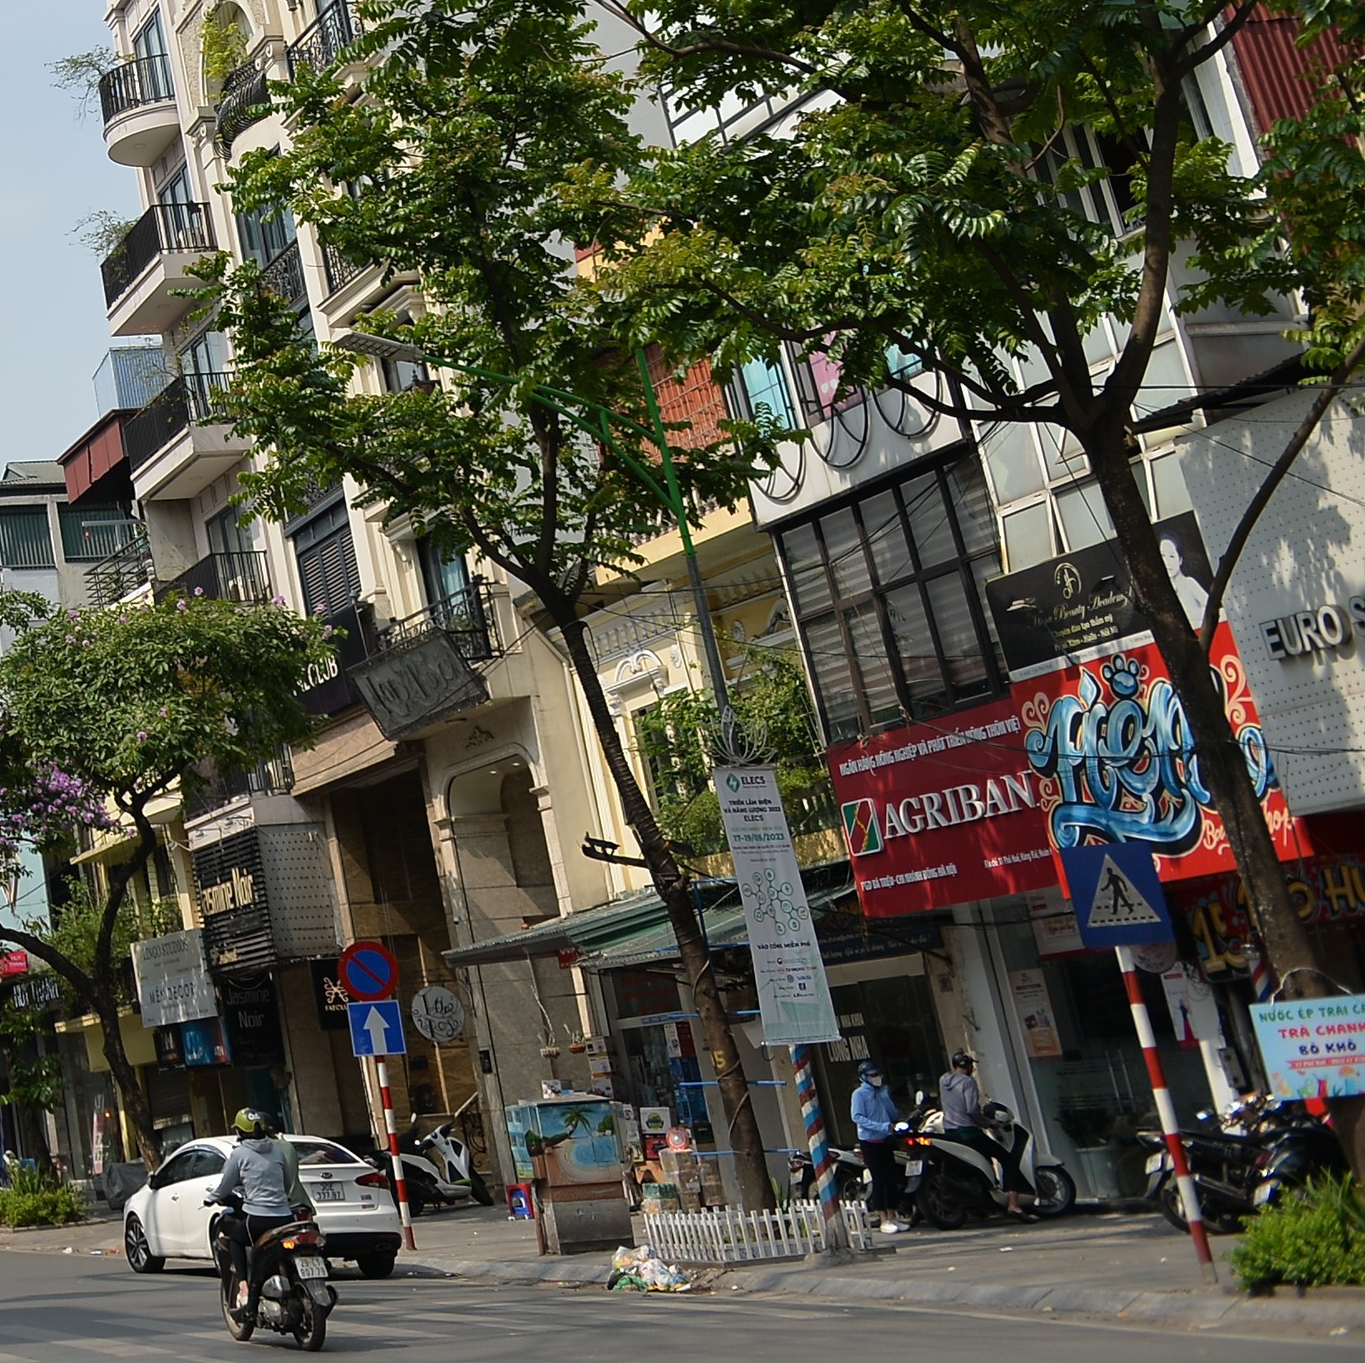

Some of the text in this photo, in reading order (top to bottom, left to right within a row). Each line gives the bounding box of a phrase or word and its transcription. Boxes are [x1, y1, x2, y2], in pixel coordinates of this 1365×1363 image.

[1259, 605, 1352, 661] EURO
[838, 759, 859, 776] NGÂN
[857, 755, 876, 772] HÀNG
[917, 739, 929, 756] VÀ
[927, 735, 946, 754] PHÁT
[741, 776, 766, 785] ELECS
[883, 770, 1042, 840] AGRIBAN
[231, 867, 254, 908] Noir
[227, 987, 270, 1005] Jasmine
[238, 1011, 264, 1029] Noir
